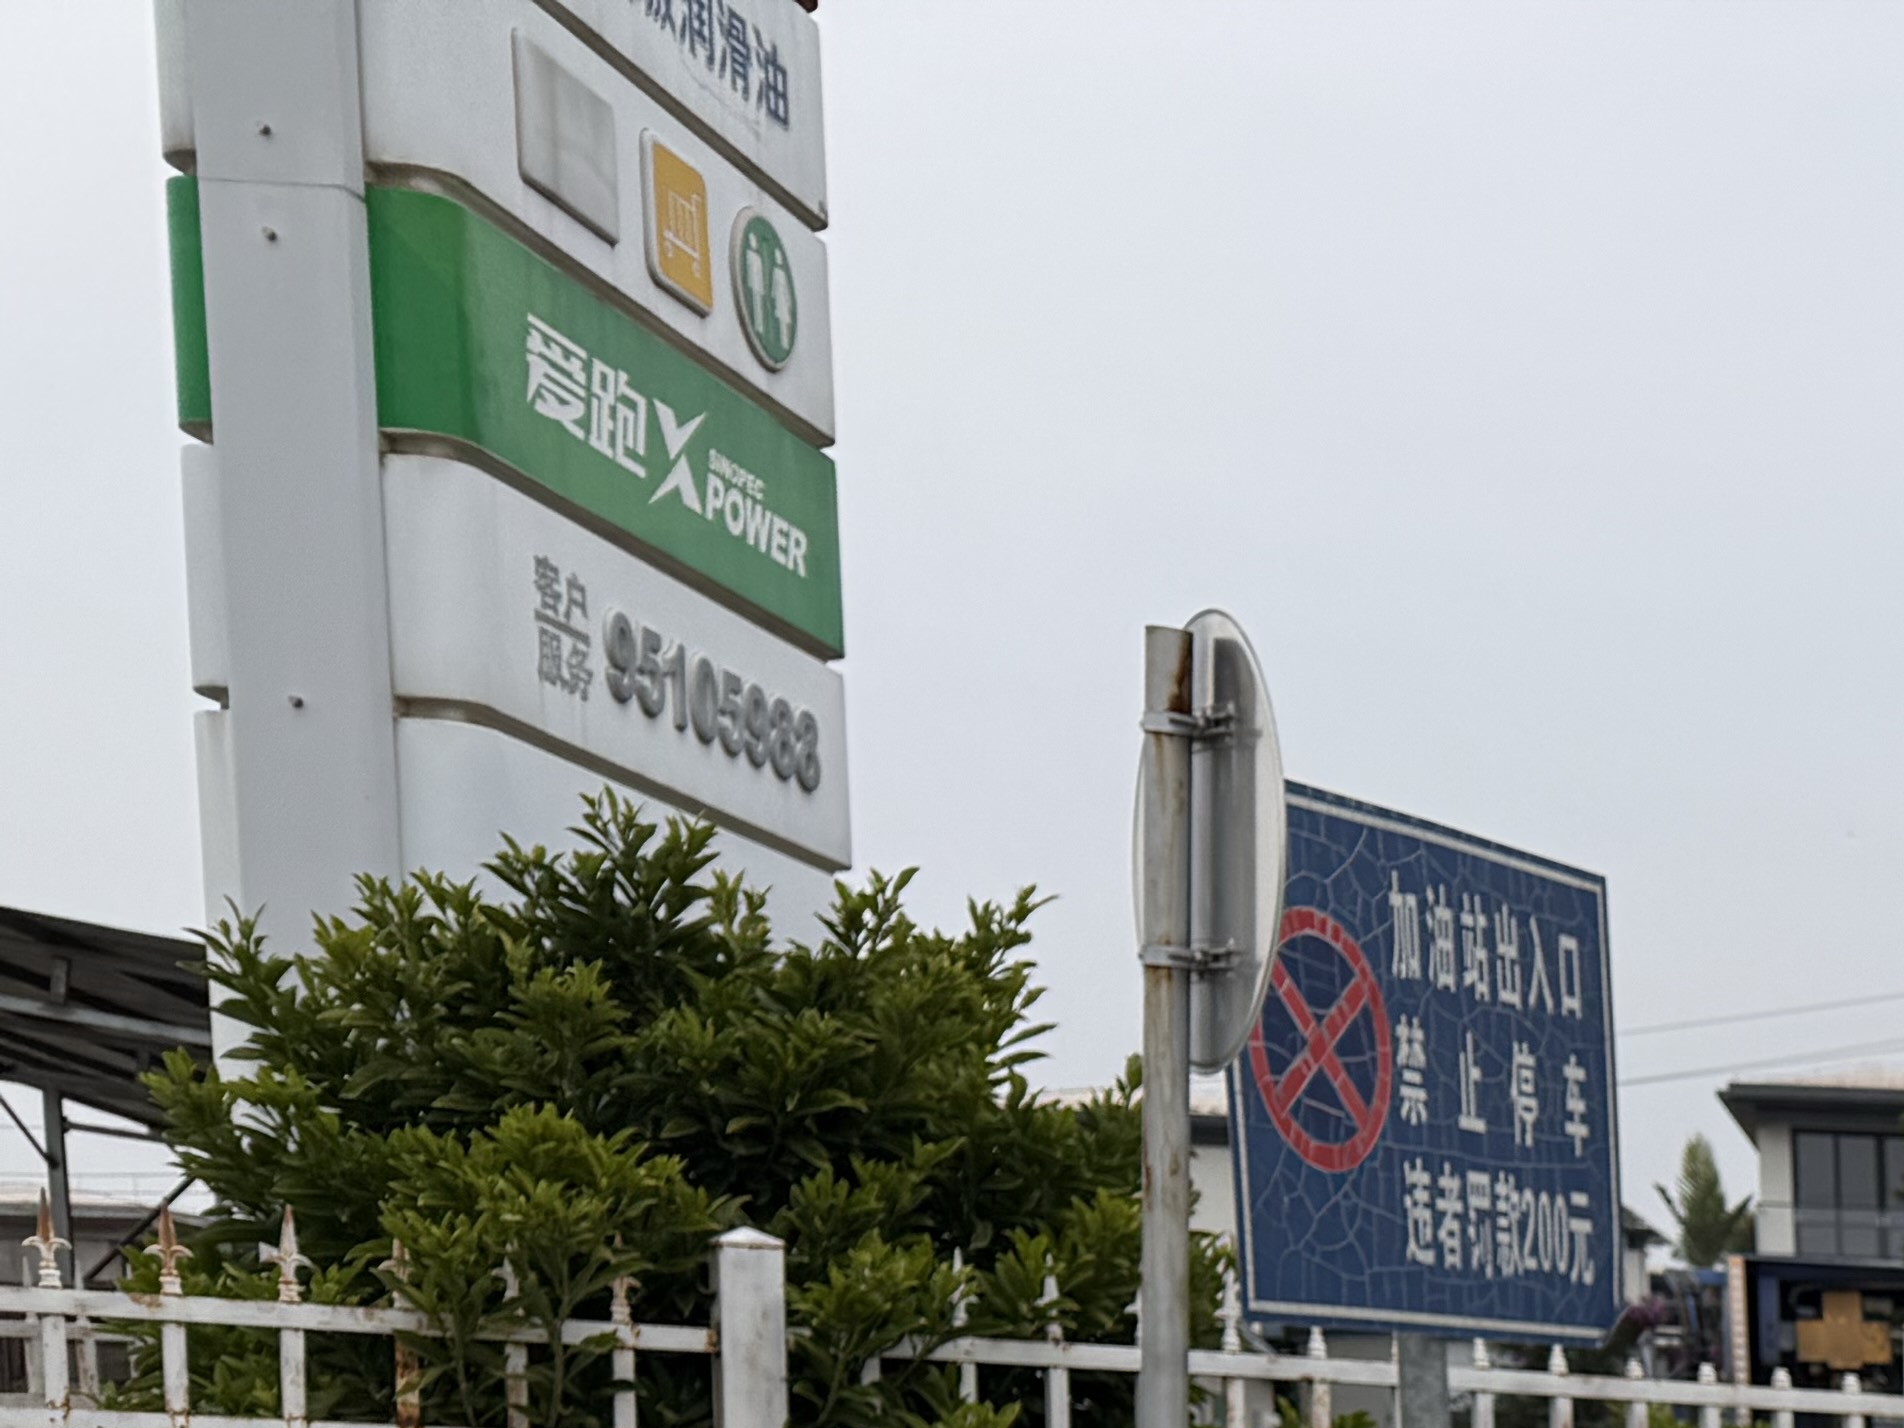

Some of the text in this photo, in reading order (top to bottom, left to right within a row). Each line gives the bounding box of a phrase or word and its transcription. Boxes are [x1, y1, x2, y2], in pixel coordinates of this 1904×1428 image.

[526, 313, 647, 479] 爱跑
[705, 472, 808, 578] POWER
[709, 449, 765, 500] SINOPEC
[603, 608, 821, 793] 95105988
[1388, 869, 1582, 1020] 加油站出入口
[1395, 1013, 1590, 1158] 禁止停车
[1403, 1156, 1595, 1286] 违者罚款200元
